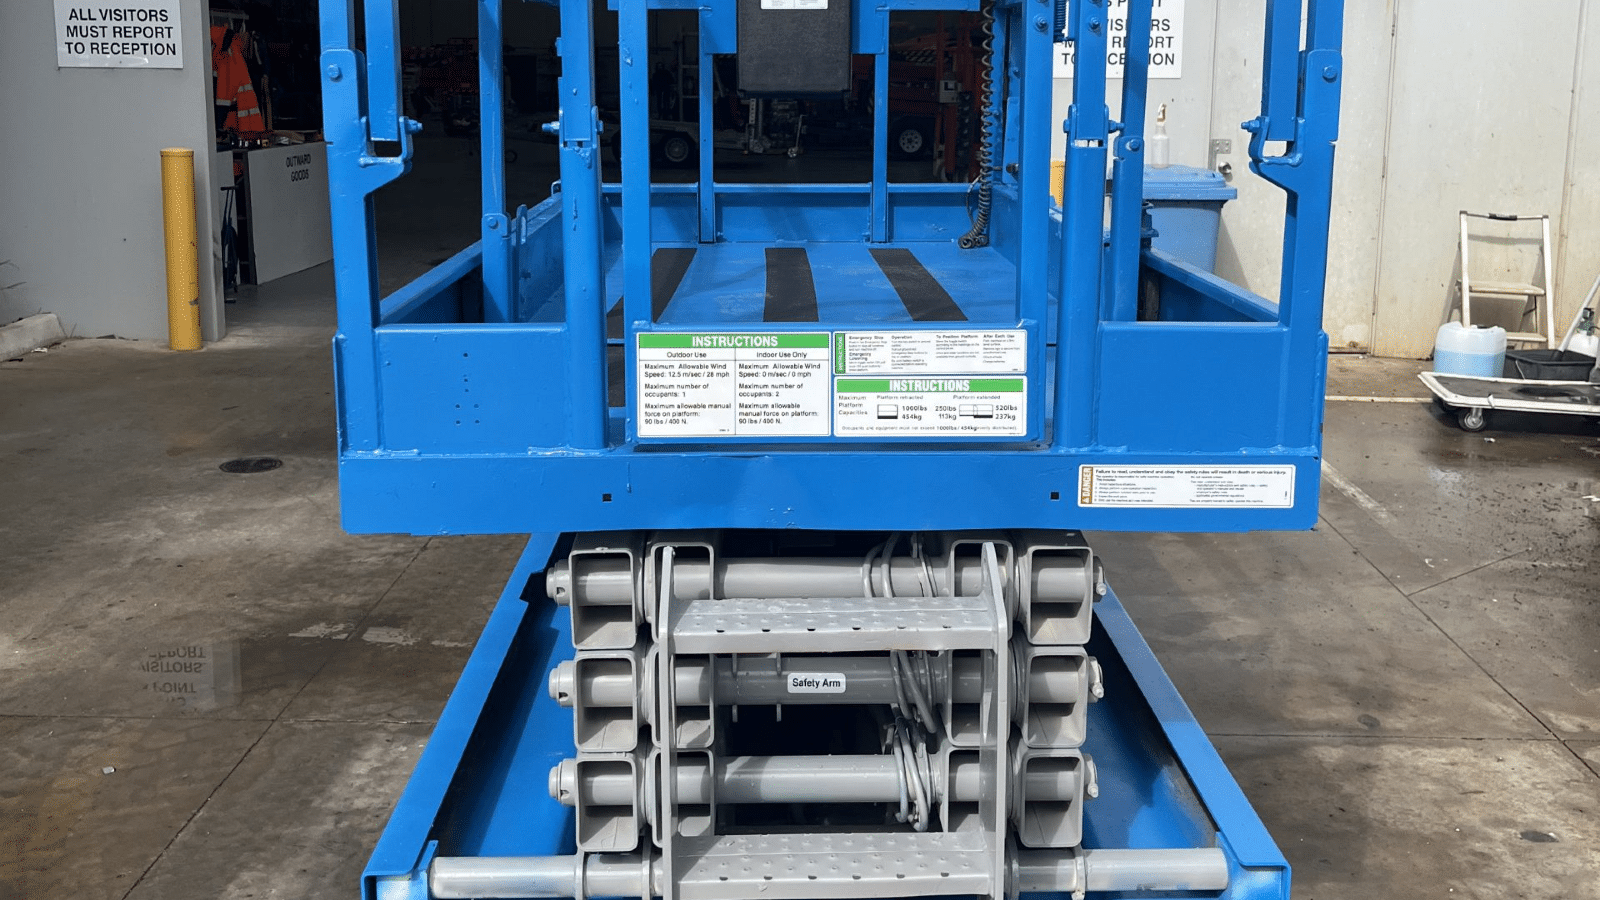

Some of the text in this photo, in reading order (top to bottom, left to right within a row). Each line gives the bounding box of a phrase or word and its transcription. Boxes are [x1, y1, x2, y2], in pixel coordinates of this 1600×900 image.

[68, 8, 169, 22] ALL VISITORS
[66, 26, 173, 38] MUST REPORT
[65, 42, 176, 55] TO RECEPTION
[286, 154, 311, 168] OUTWARD
[291, 169, 309, 182] GOODS
[692, 336, 778, 347] INSTRUCTIONS
[889, 380, 970, 391] INSTRUCTIONS
[1083, 468, 1092, 497] DANGER
[793, 678, 841, 688] Safety Arm
